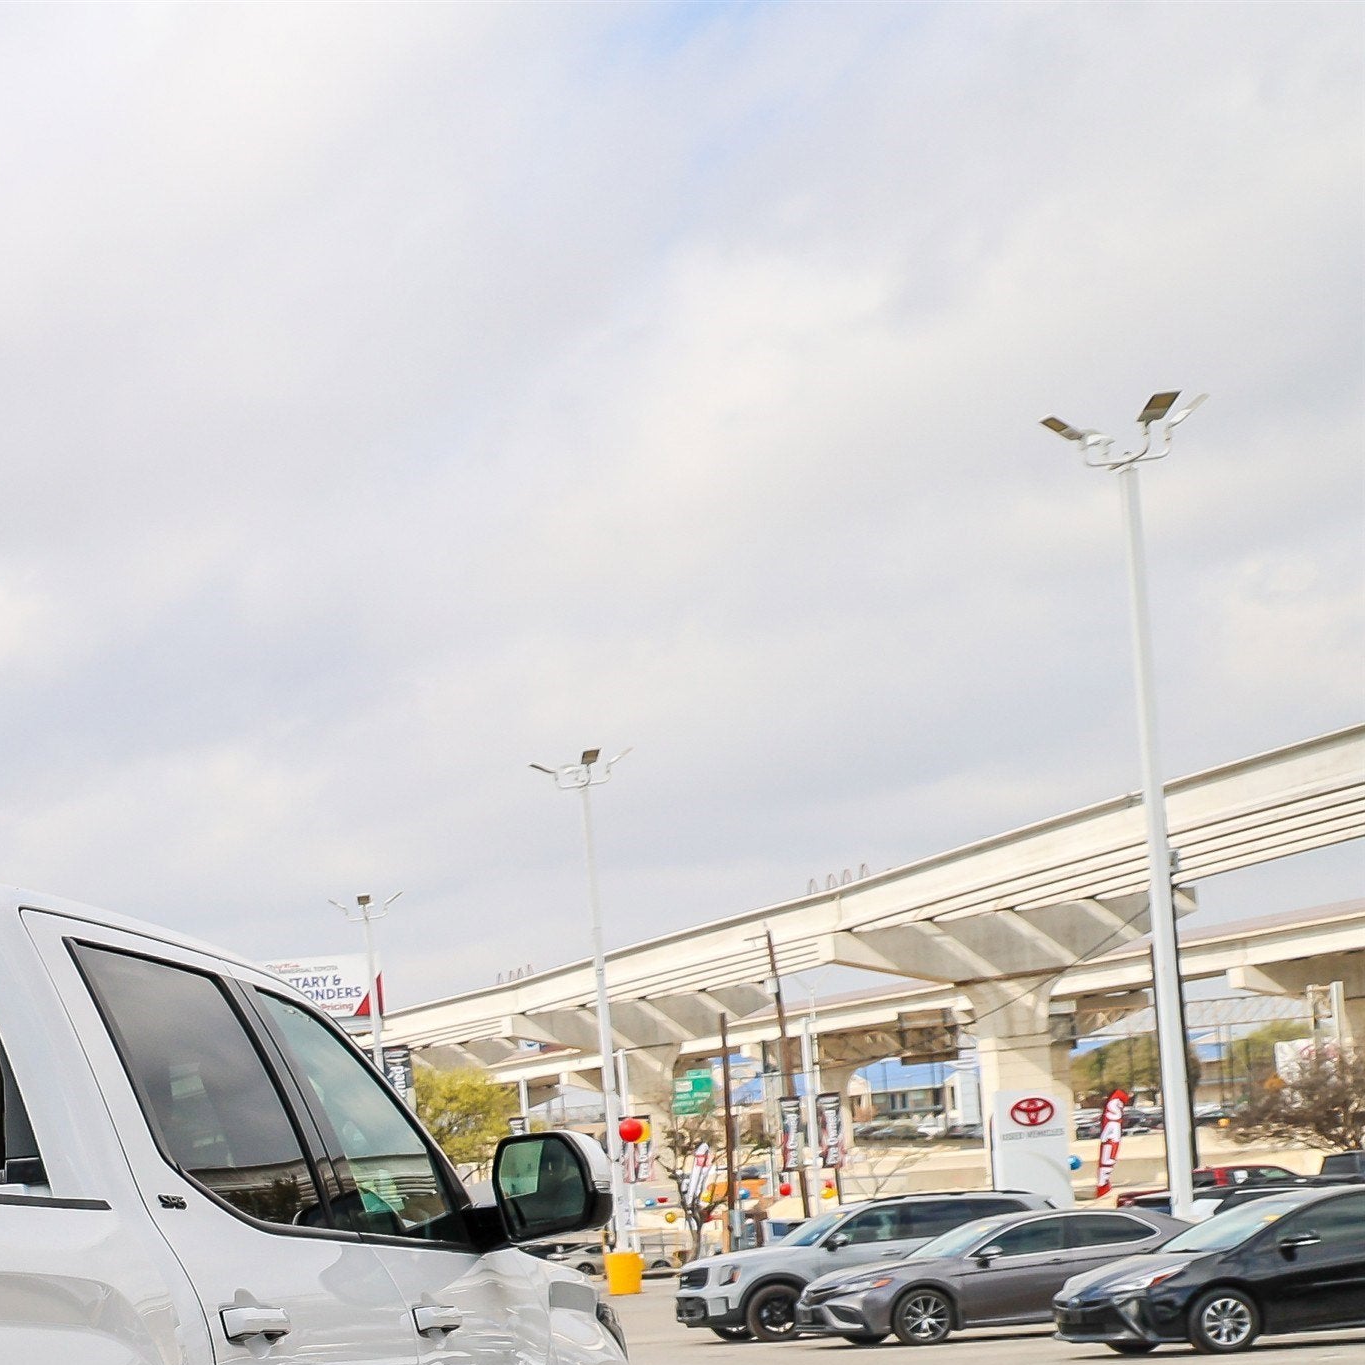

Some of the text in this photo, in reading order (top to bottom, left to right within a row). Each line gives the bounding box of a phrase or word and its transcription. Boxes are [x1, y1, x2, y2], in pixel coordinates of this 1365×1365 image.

[332, 974, 342, 986] &
[320, 1003, 354, 1012] Pricing
[1098, 1098, 1125, 1187] SALE
